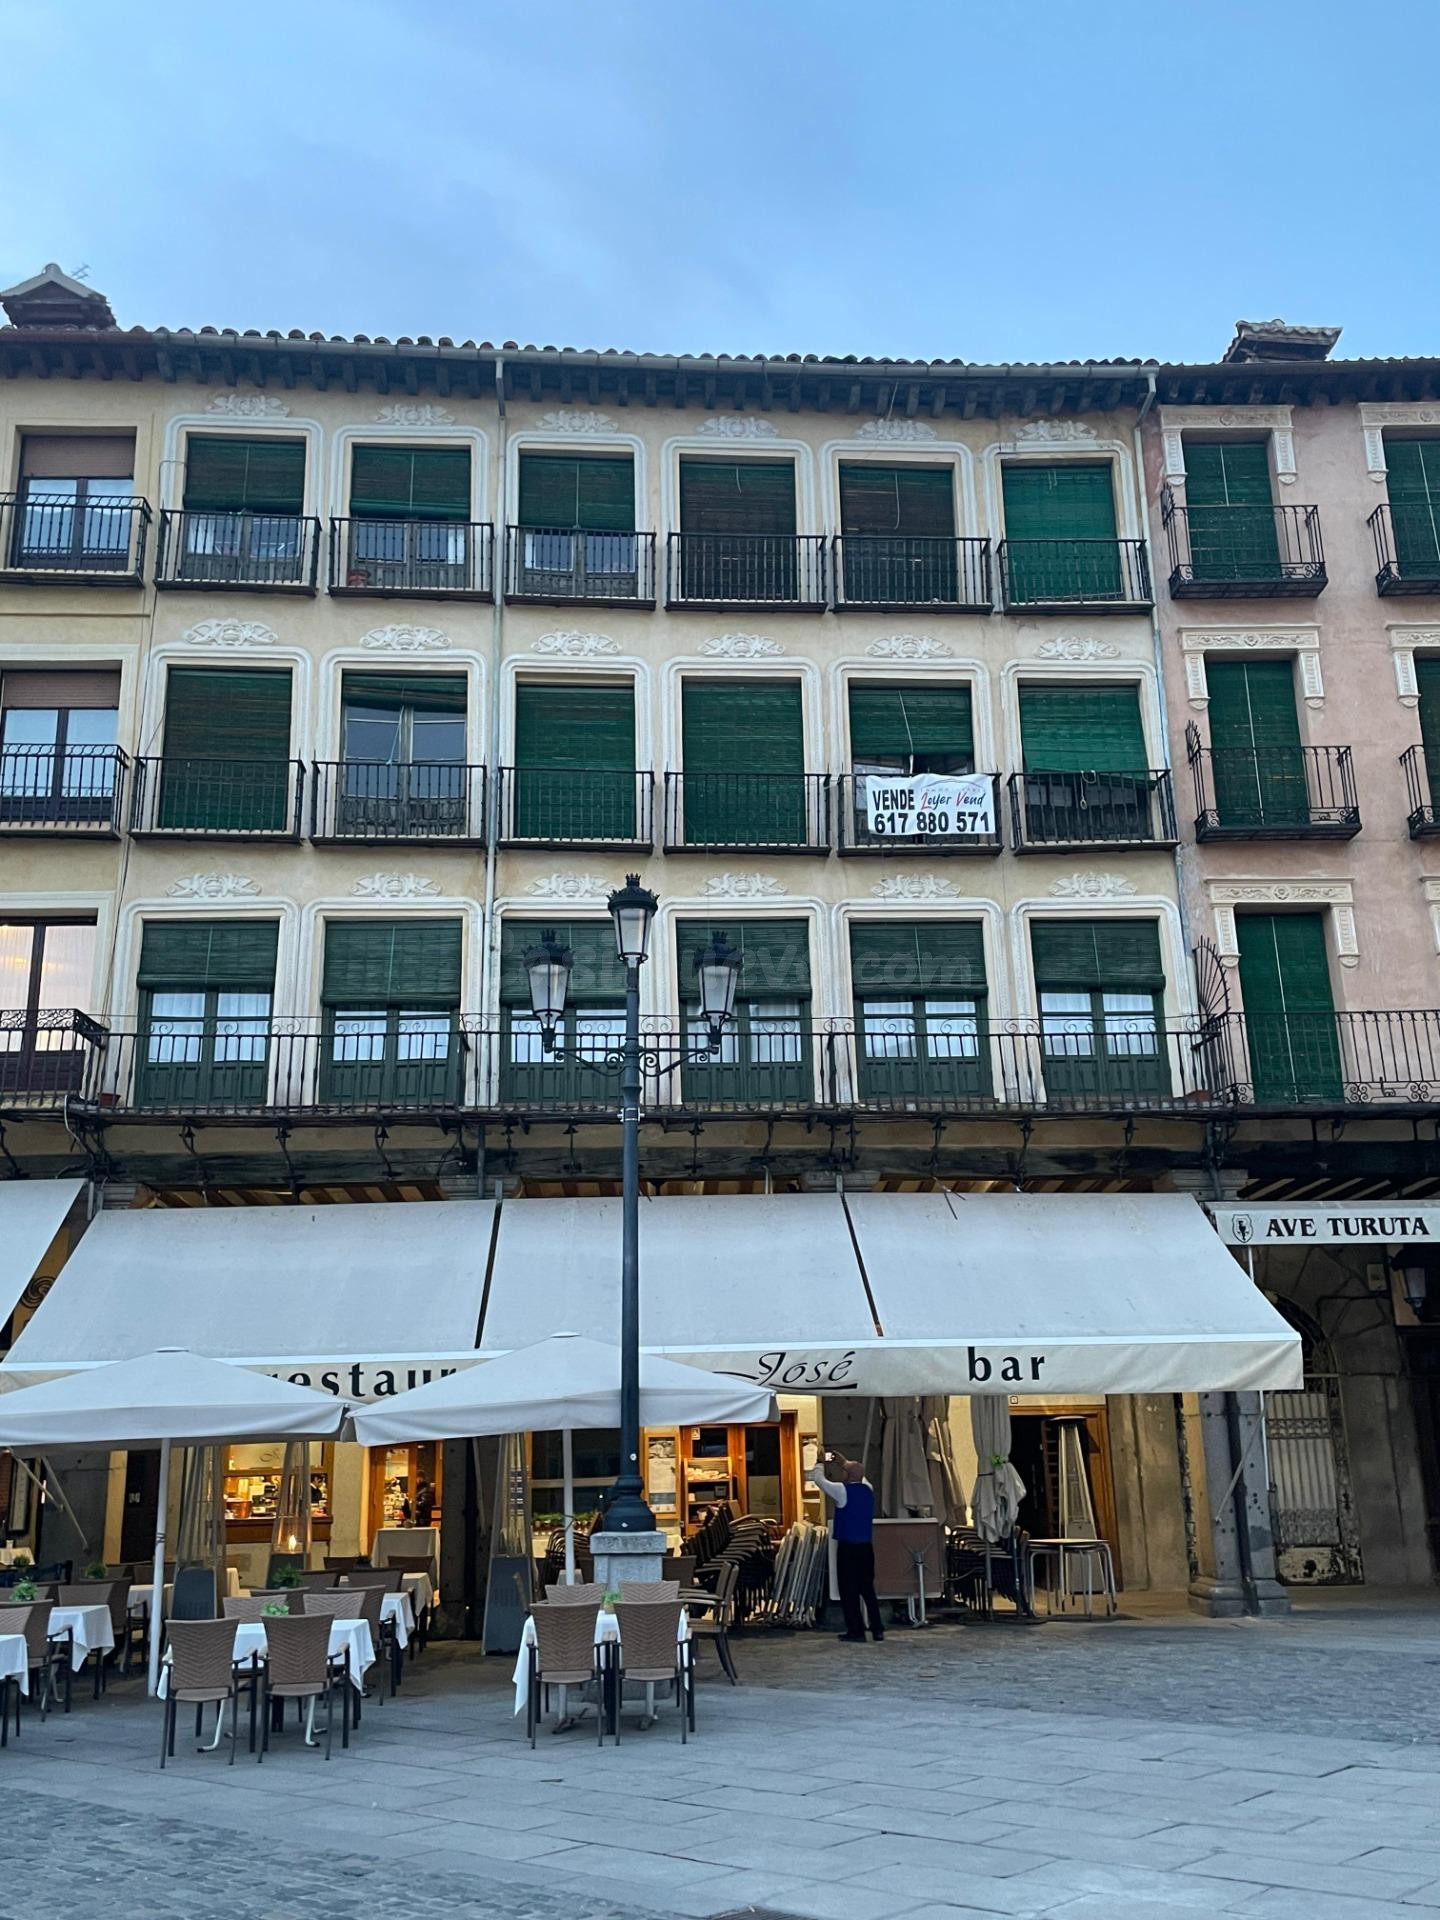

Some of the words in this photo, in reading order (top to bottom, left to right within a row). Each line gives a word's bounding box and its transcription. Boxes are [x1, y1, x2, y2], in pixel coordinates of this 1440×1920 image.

[872, 789, 915, 811] VENDE
[874, 812, 909, 834] 617
[916, 811, 949, 833] 880
[956, 811, 989, 832] 571
[1266, 1218, 1317, 1237] AVE
[1327, 1217, 1430, 1236] TURUTA
[757, 1351, 856, 1386] José
[967, 1346, 1045, 1382] bar
